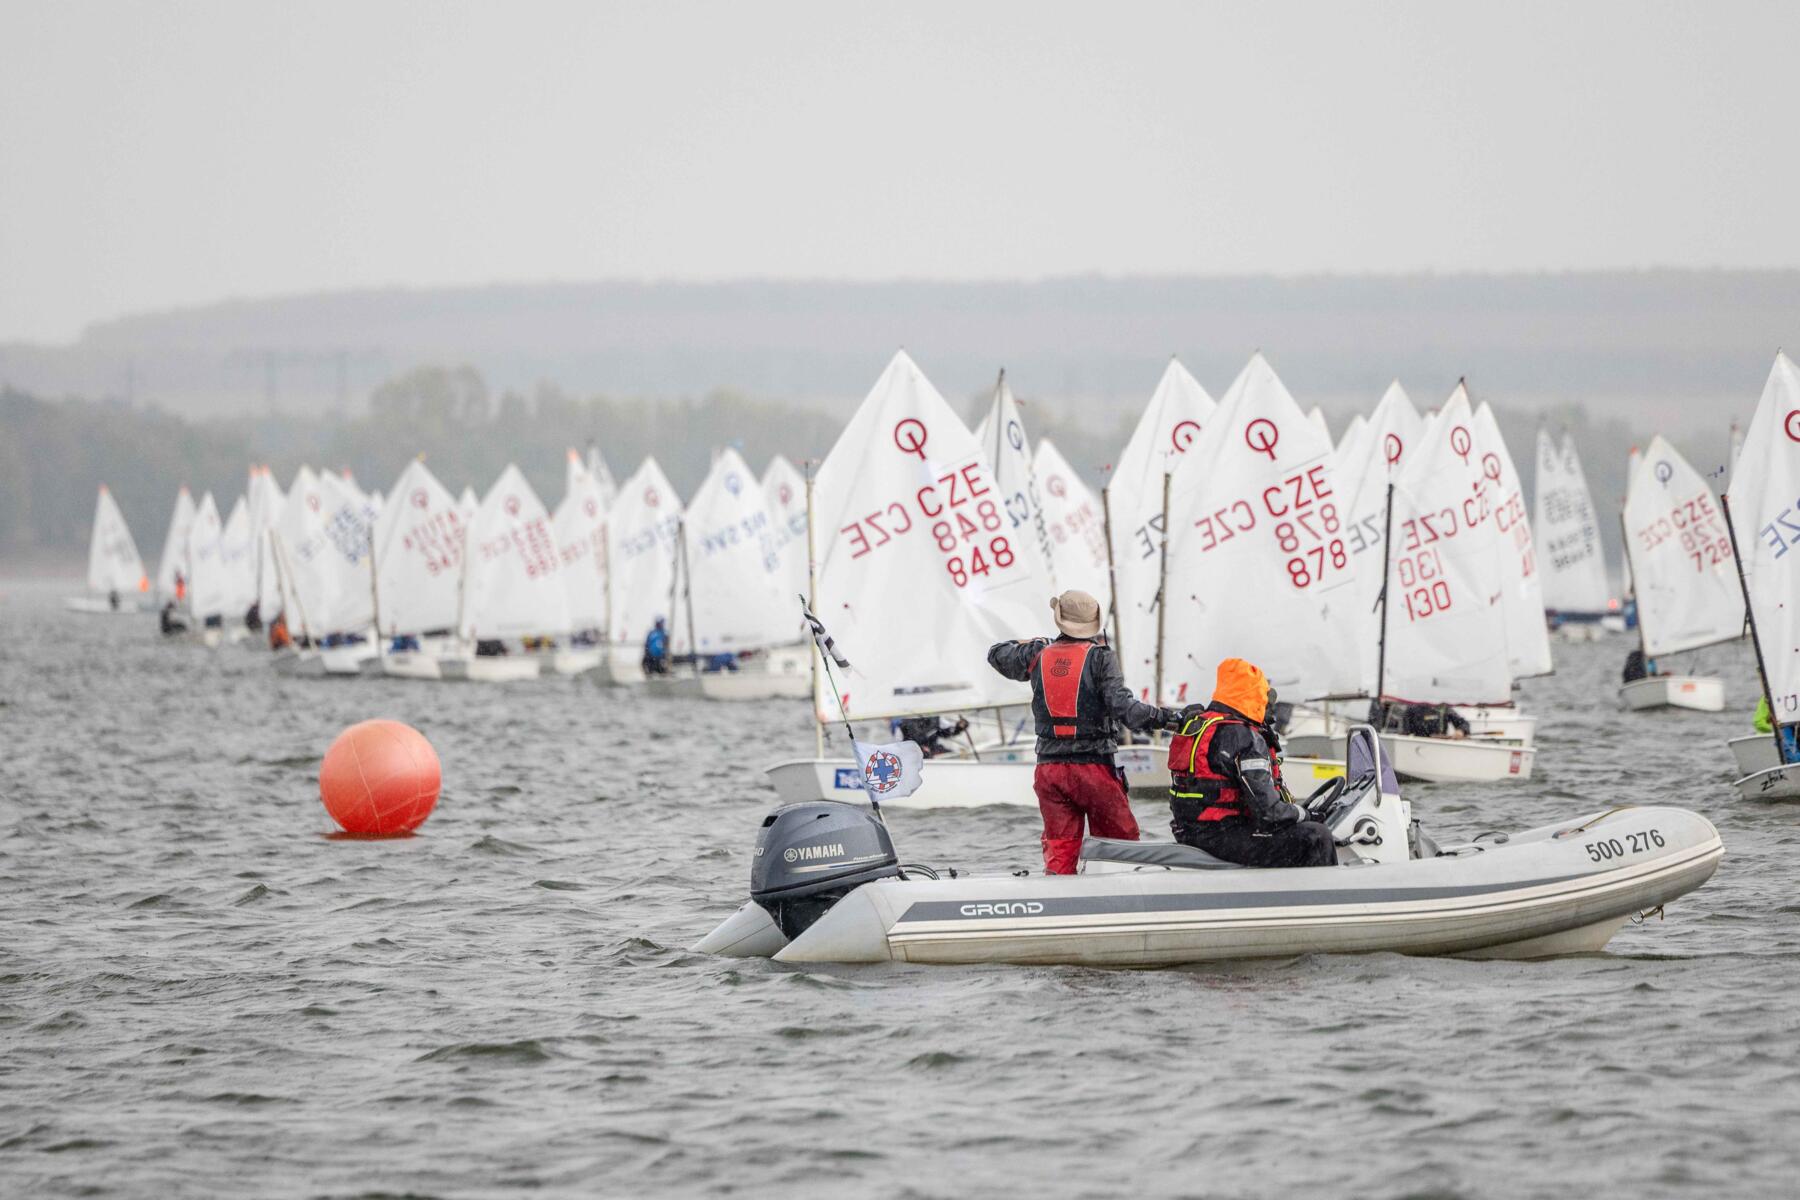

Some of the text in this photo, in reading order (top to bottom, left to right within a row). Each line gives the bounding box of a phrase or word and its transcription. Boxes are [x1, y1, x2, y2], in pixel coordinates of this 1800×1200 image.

[917, 463, 990, 518] CZE
[1263, 465, 1333, 518] CZE
[1670, 492, 1714, 531] CZE
[946, 536, 1015, 588] 848
[1287, 538, 1347, 589] 878
[1690, 536, 1732, 574] 728
[1405, 580, 1452, 622] 130
[798, 843, 845, 860] YAMAHA
[1585, 829, 1666, 863] 500 276
[960, 902, 1044, 917] GRAND
